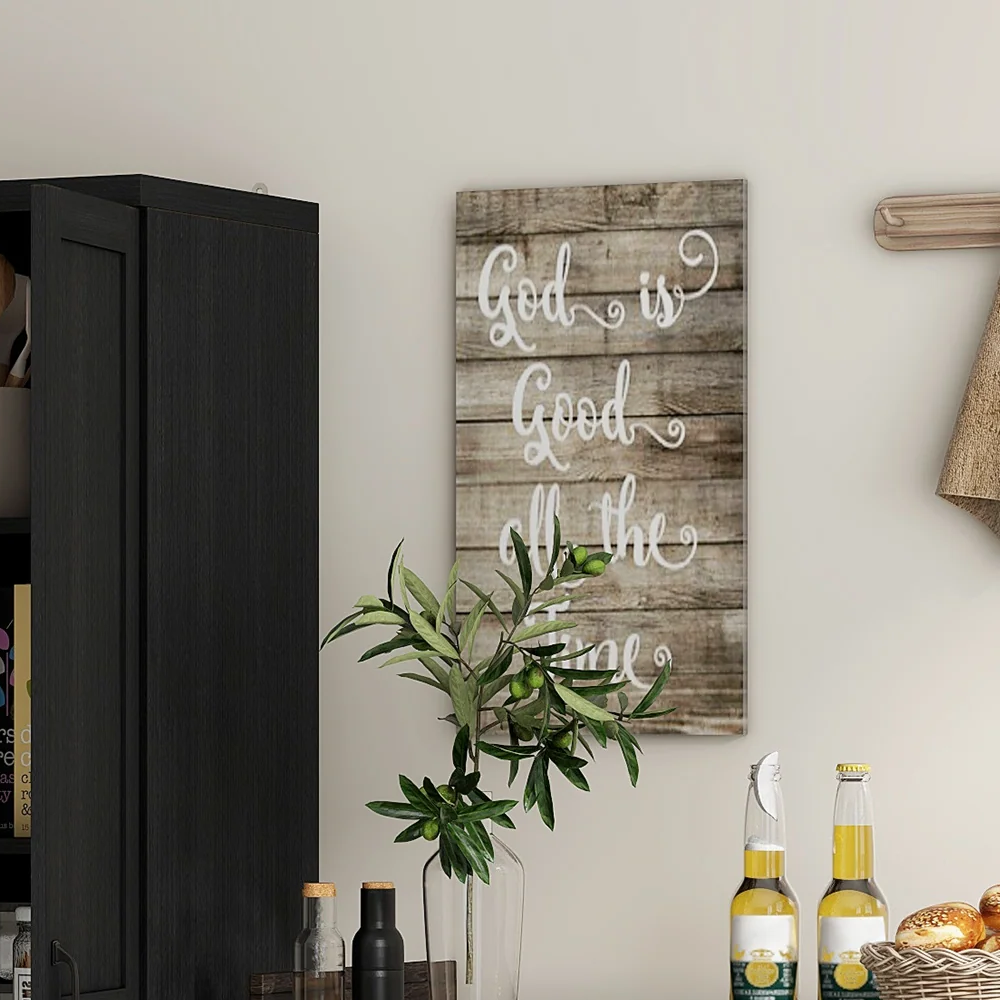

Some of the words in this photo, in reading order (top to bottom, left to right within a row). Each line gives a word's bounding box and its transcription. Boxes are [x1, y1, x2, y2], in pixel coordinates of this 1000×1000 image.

[477, 241, 625, 352] God
[639, 229, 719, 327] is
[512, 359, 686, 471] Good
[588, 473, 698, 571] the
